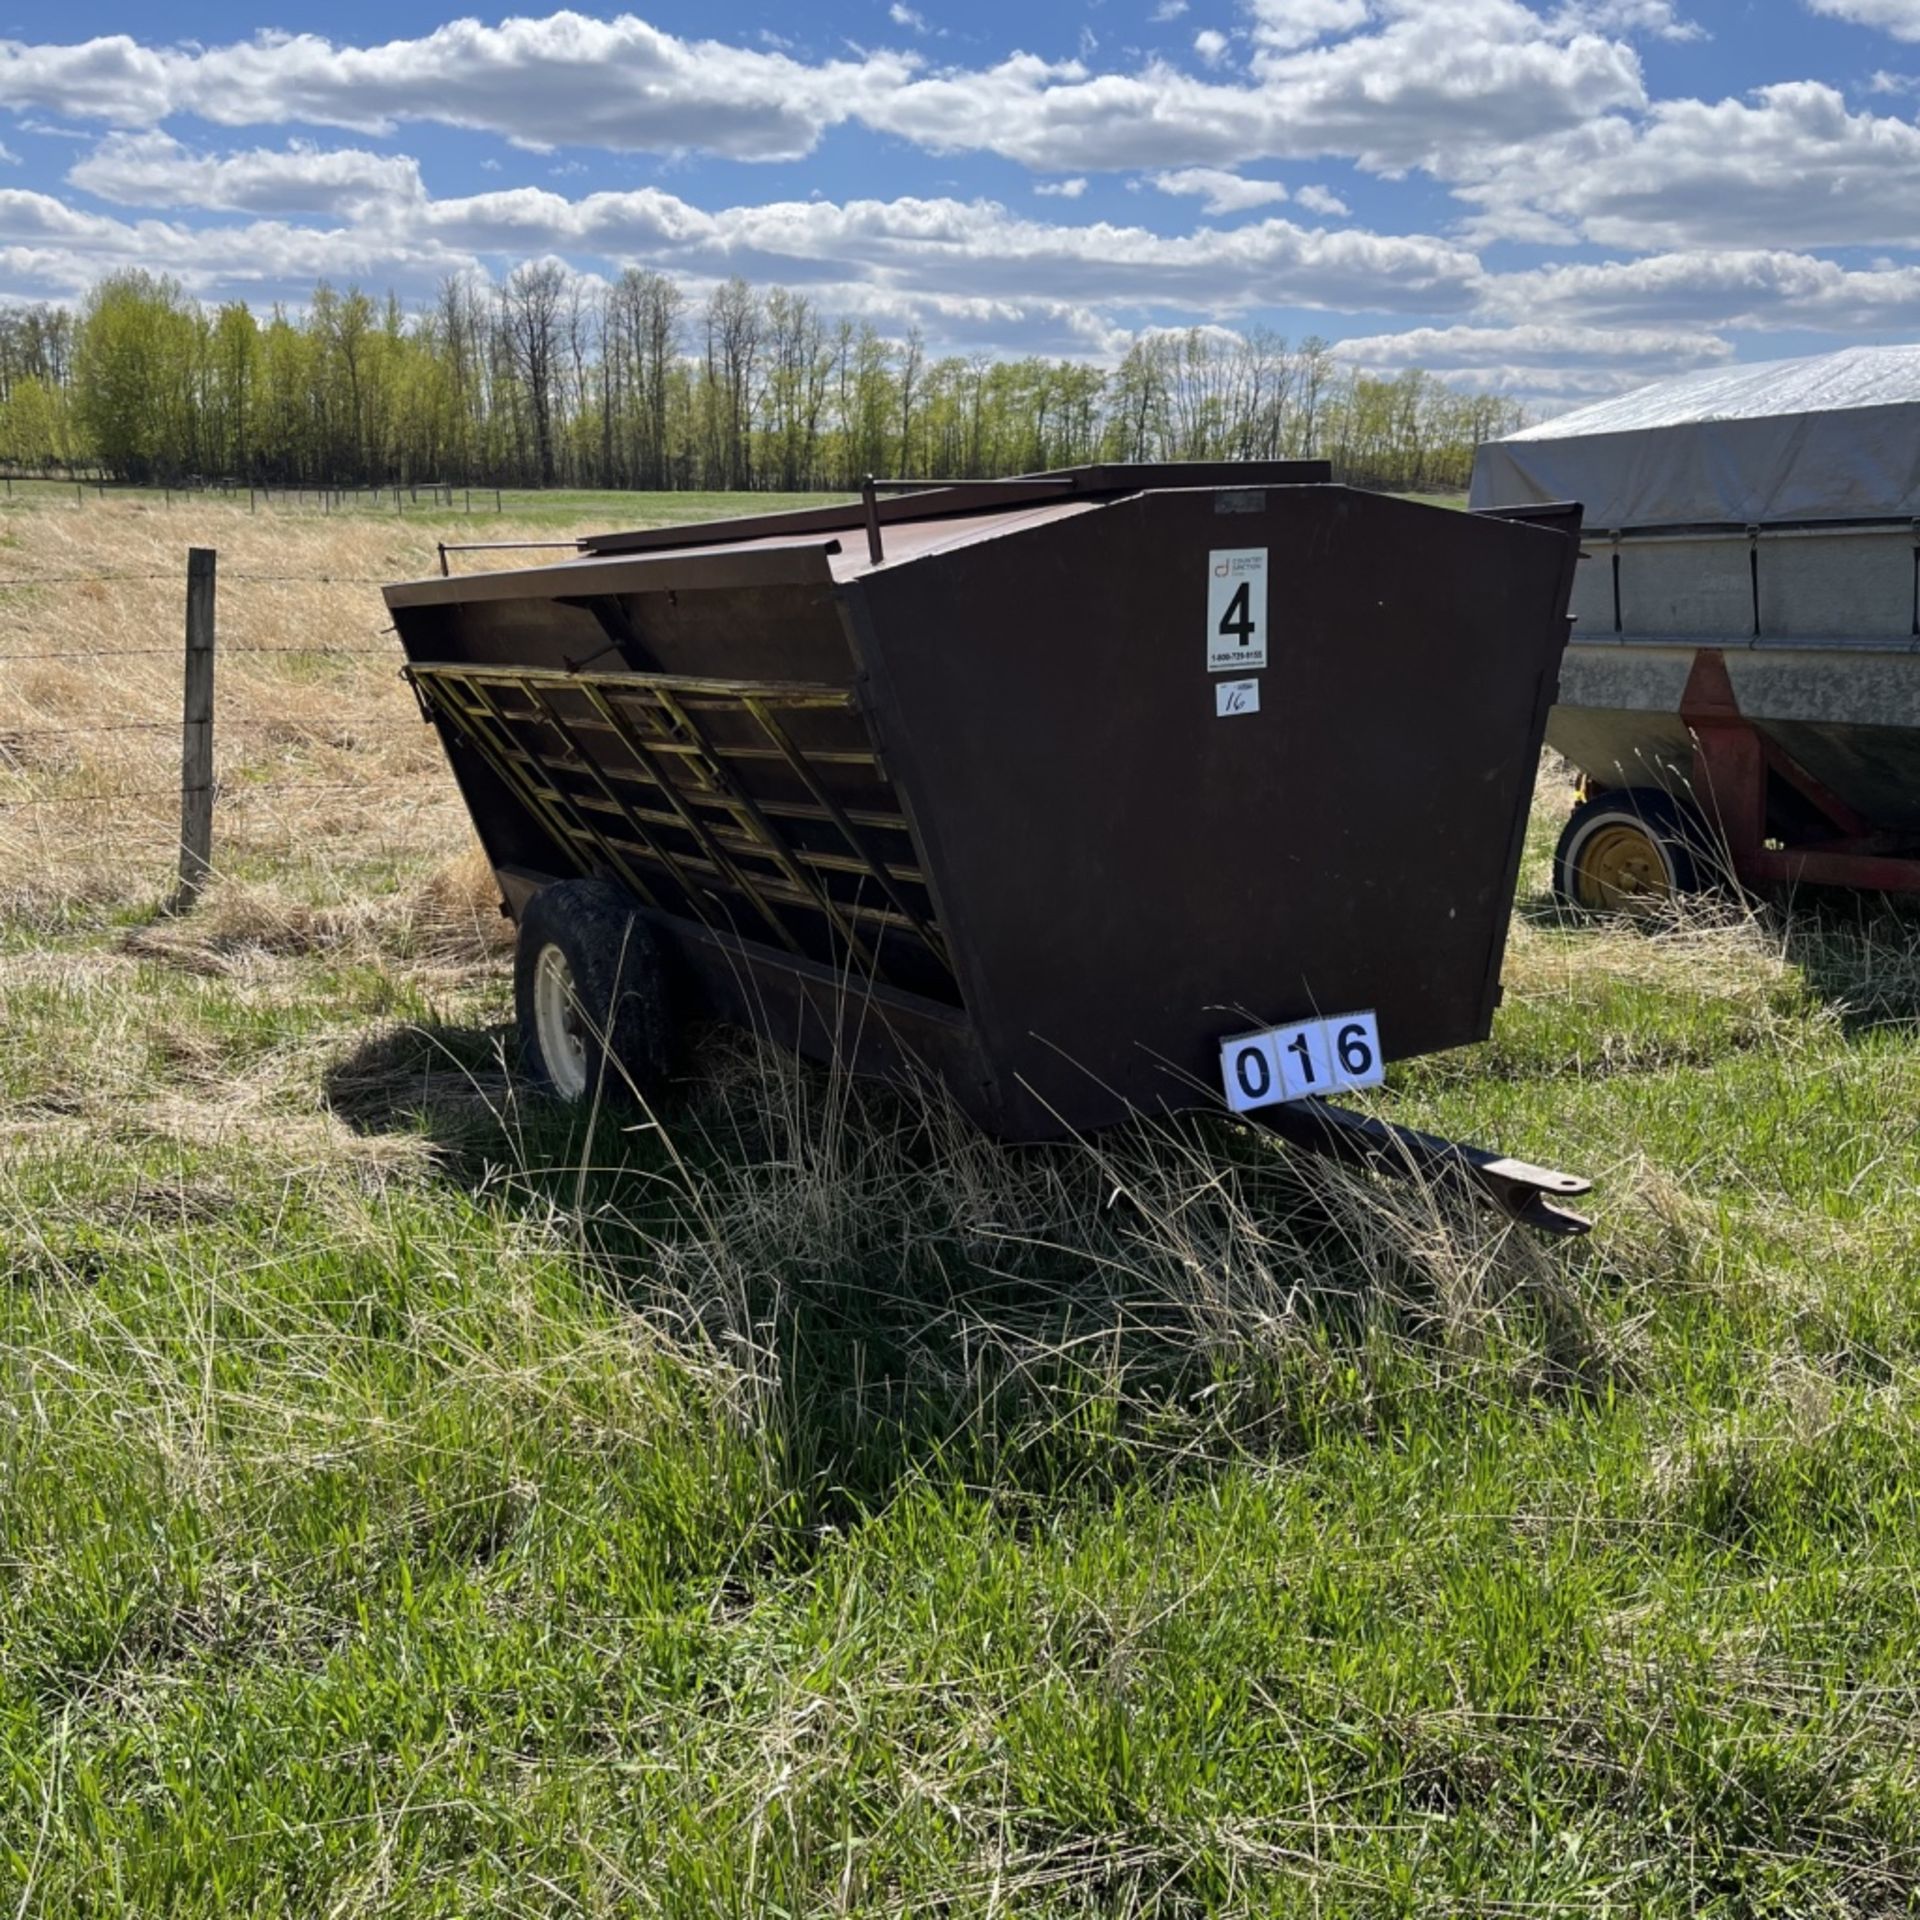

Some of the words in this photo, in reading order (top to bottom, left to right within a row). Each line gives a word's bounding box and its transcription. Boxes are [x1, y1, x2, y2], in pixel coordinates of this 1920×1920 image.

[1219, 581, 1255, 646] 4
[1225, 691, 1246, 711] 16
[1236, 1023, 1373, 1099] 016
